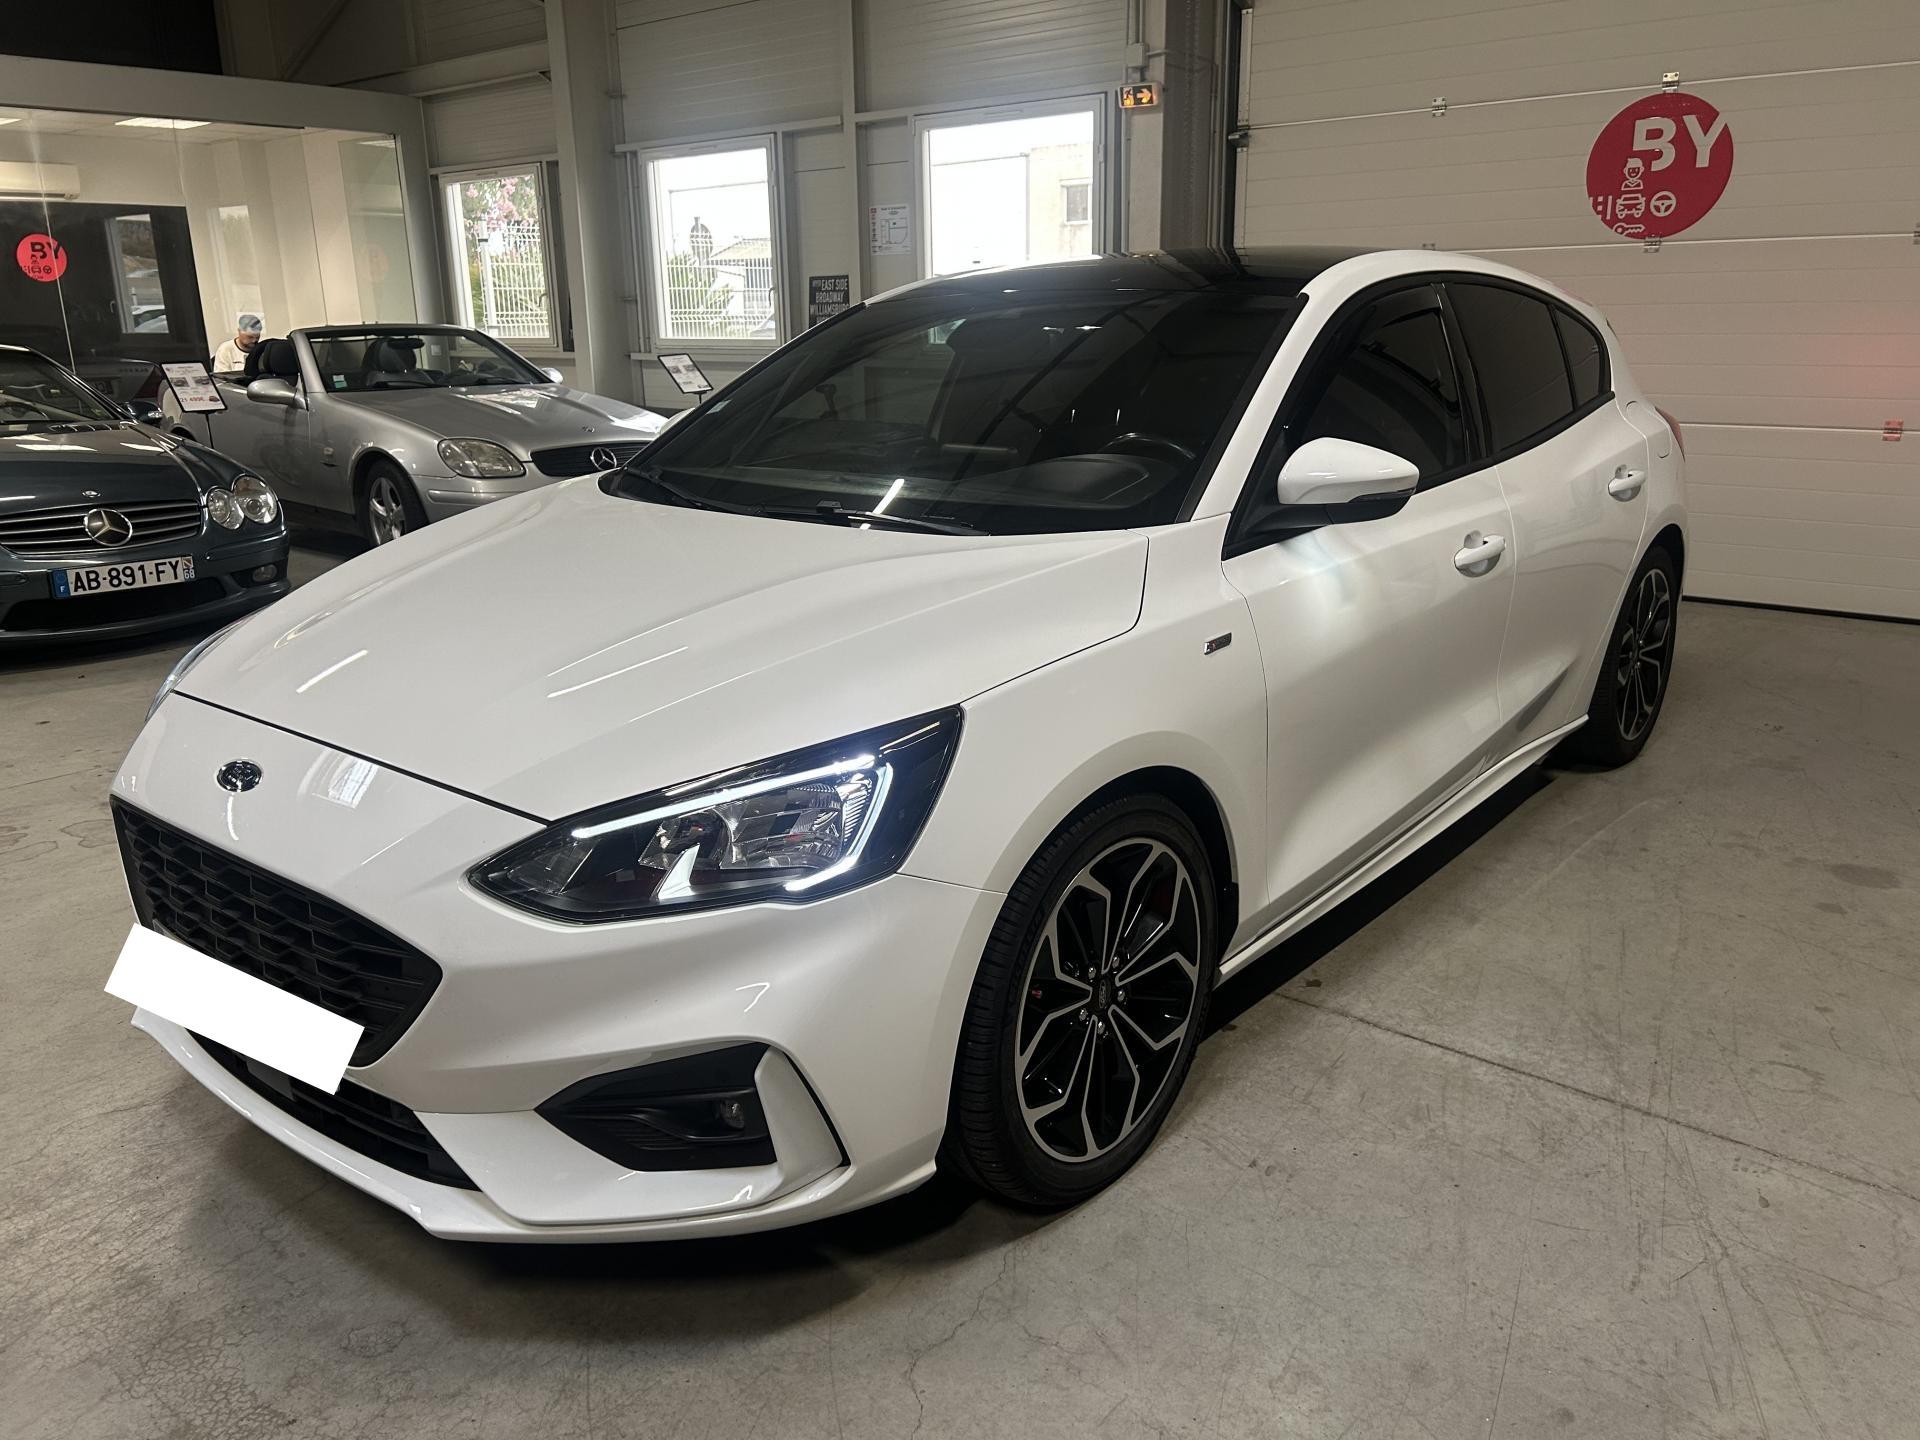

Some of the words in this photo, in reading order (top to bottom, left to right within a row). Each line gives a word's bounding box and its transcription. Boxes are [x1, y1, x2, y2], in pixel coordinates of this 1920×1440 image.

[1633, 112, 1727, 172] BY
[30, 241, 62, 259] BY
[821, 279, 835, 290] EAST
[835, 278, 848, 290] SIDE
[815, 291, 845, 303] BROADWAY
[73, 560, 180, 593] AB-891-FY
[184, 568, 195, 579] 68
